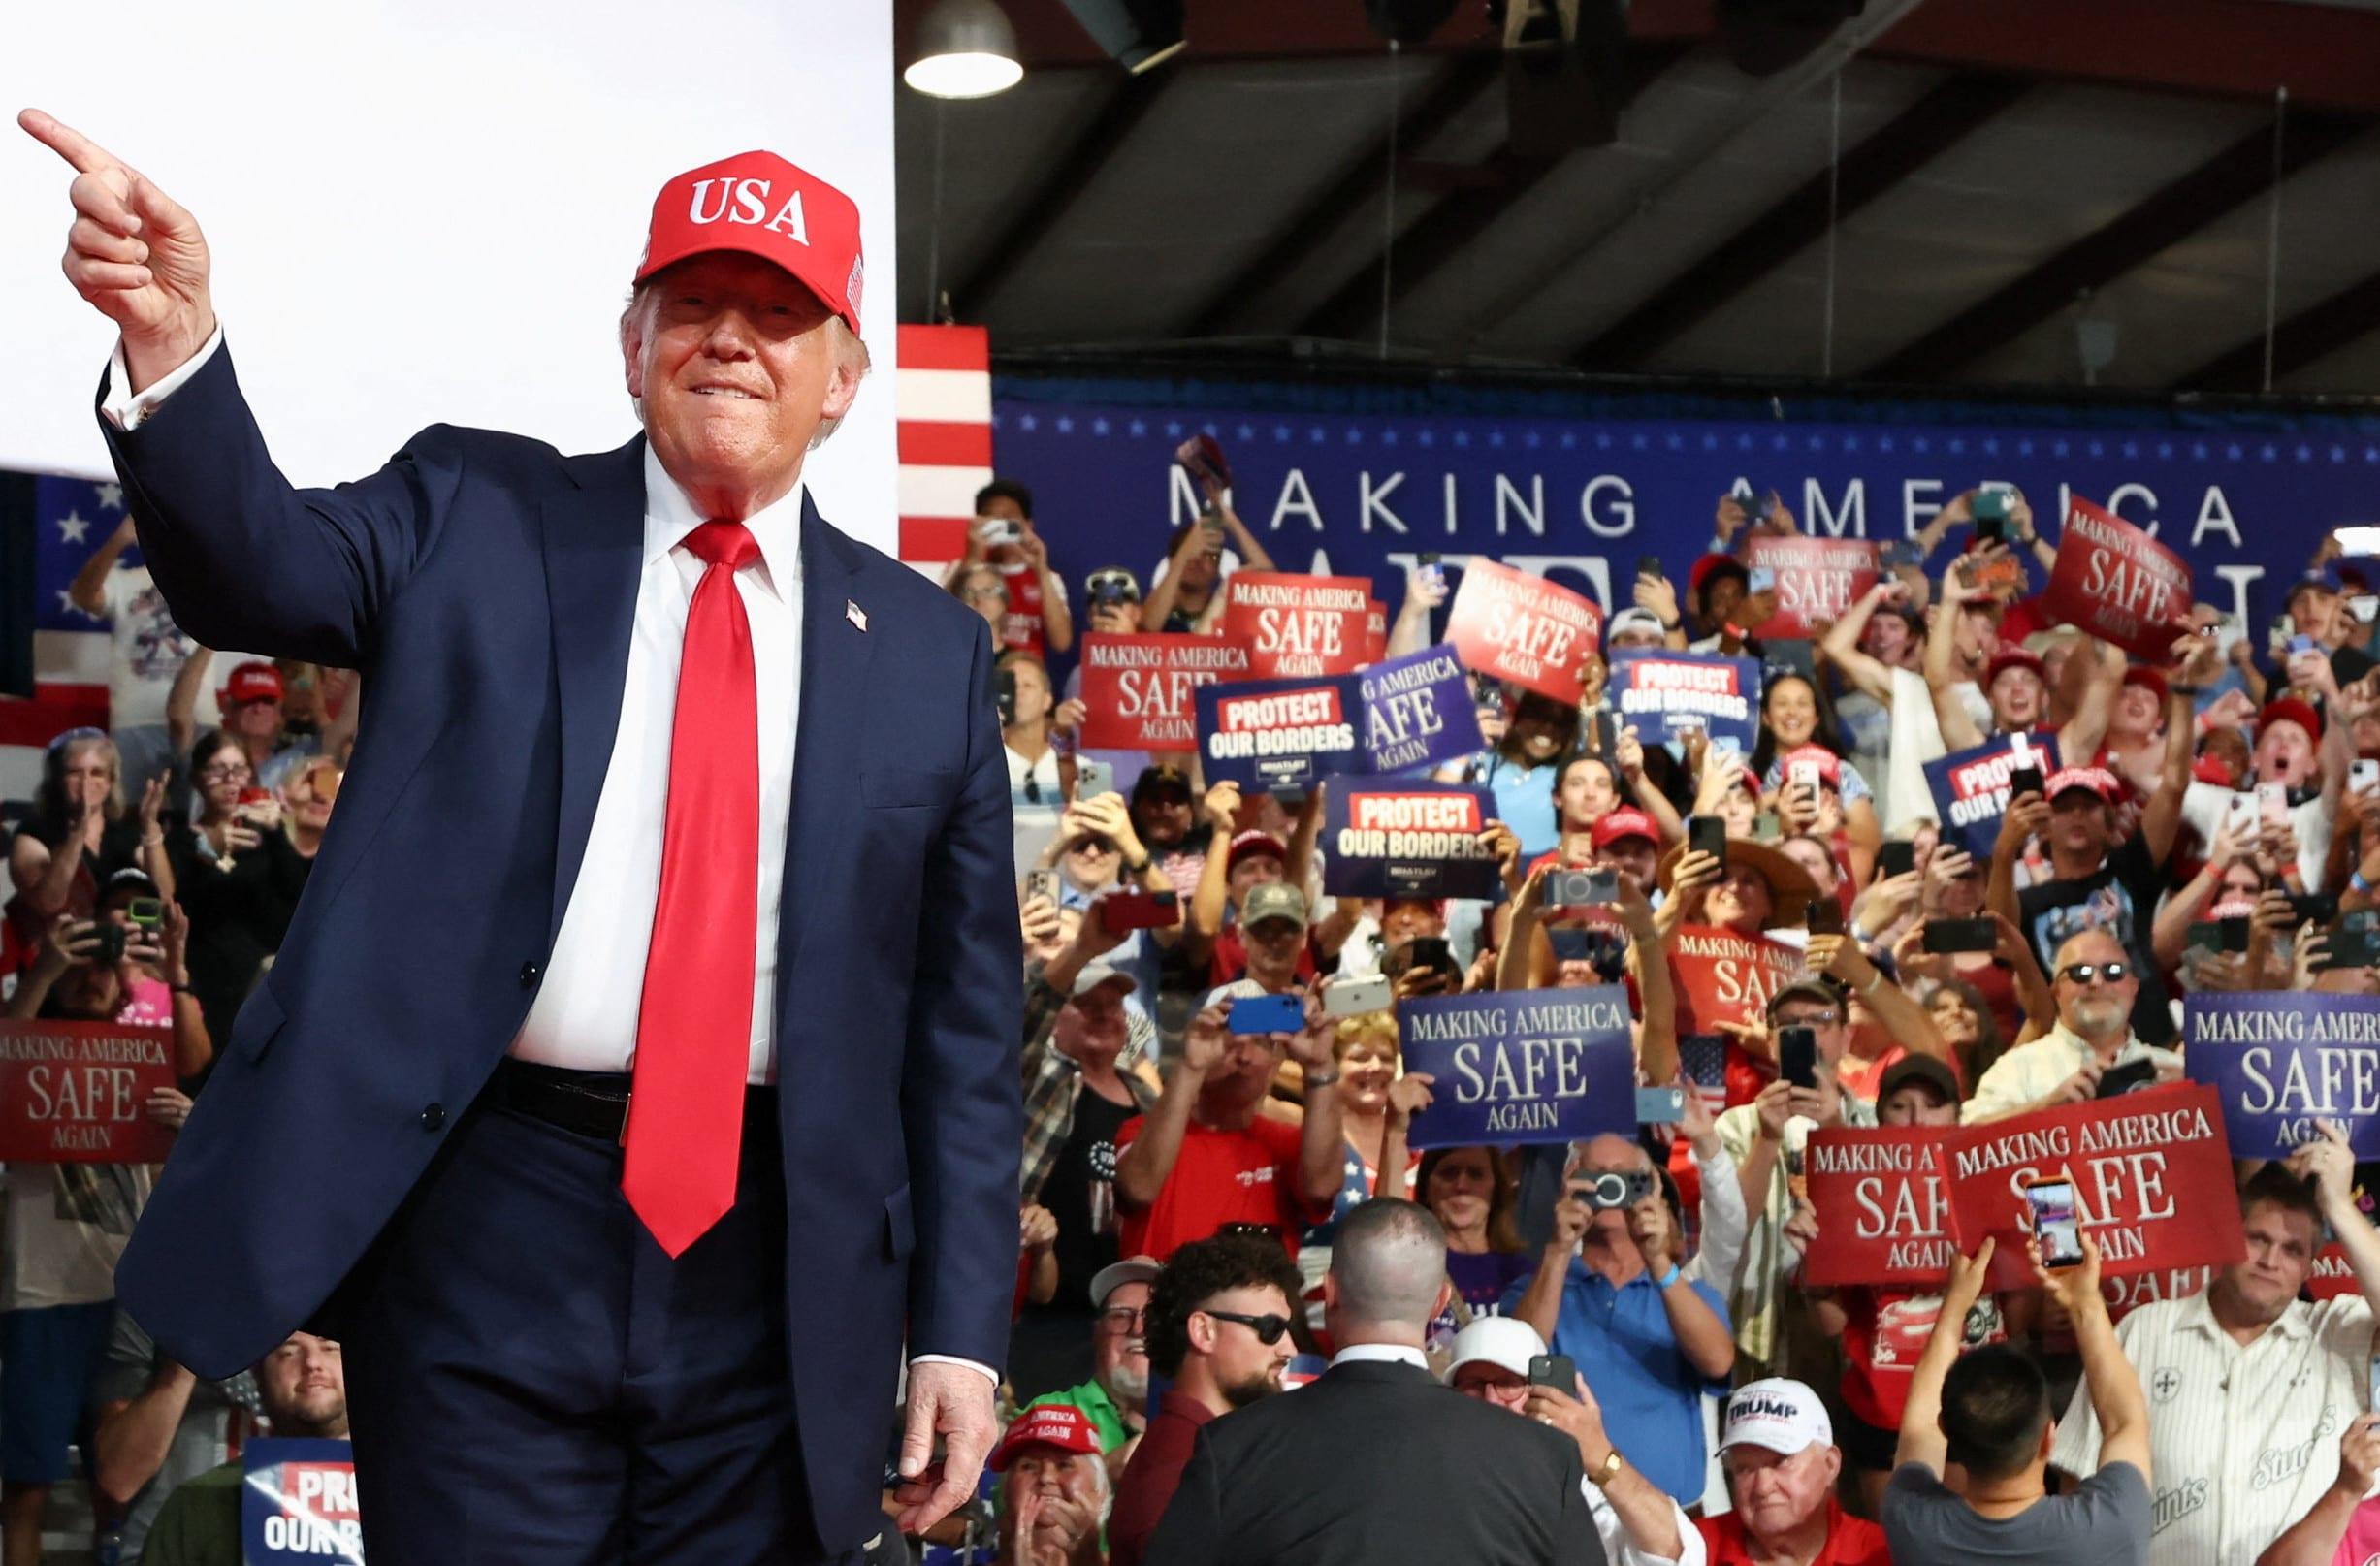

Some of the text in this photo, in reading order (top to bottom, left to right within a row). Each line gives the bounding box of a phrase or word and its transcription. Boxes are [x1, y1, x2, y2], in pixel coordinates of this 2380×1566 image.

[689, 176, 811, 247] USA
[1169, 464, 2243, 549] MAKING MEICA
[2071, 510, 2132, 558] MAKING
[1233, 583, 1367, 612] MAKING AMERICA
[1779, 569, 1854, 612] SAFE
[2082, 548, 2171, 625] SAFE
[1255, 608, 1344, 656] SAFE
[1482, 598, 1577, 669] SAFE
[1539, 593, 1599, 637] AMERICA
[1089, 644, 1249, 669] MAKING AMERICA
[1273, 655, 1324, 676] AGAIN
[1494, 650, 1543, 682] AGAIN
[1378, 655, 1460, 697] AMERICA
[1638, 662, 1731, 693] PROTECT
[1226, 690, 1332, 730] PROTECT
[1365, 687, 1443, 751] AFE
[1621, 687, 1662, 715] OUR
[1663, 687, 1748, 721] BORDERS
[1139, 719, 1195, 740] AGAIN
[1209, 723, 1355, 759] OUR BORDERS
[1375, 737, 1430, 772] AGAIN
[1958, 748, 2048, 796] PROT
[1360, 797, 1471, 829] PROTECT
[1949, 792, 1998, 827] OUR
[1337, 828, 1490, 859] OUR BORDERS
[1678, 933, 1758, 963] MAKING
[1714, 959, 1790, 1008] SAF
[1411, 1002, 1624, 1041] MAKING AMERICA
[2194, 1010, 2380, 1044] MAKING AMER
[79, 1037, 167, 1064] AMERICA
[1454, 1037, 1588, 1103] SAFE
[2240, 1046, 2379, 1115] SAFE
[27, 1064, 137, 1122] SAFE
[1485, 1102, 1559, 1132] AGAIN
[2275, 1117, 2354, 1147] AGN
[52, 1125, 112, 1150] AGAIN
[1955, 1125, 2071, 1181] MAKING
[2077, 1106, 2215, 1154] AMERICA
[1814, 1143, 1913, 1174] MAKING
[1854, 1175, 1949, 1240] SAF
[2097, 1225, 2146, 1262] AIN
[1729, 1398, 1798, 1422] TRUMP
[2151, 1476, 2209, 1538] ints
[264, 1515, 335, 1555] OUR
